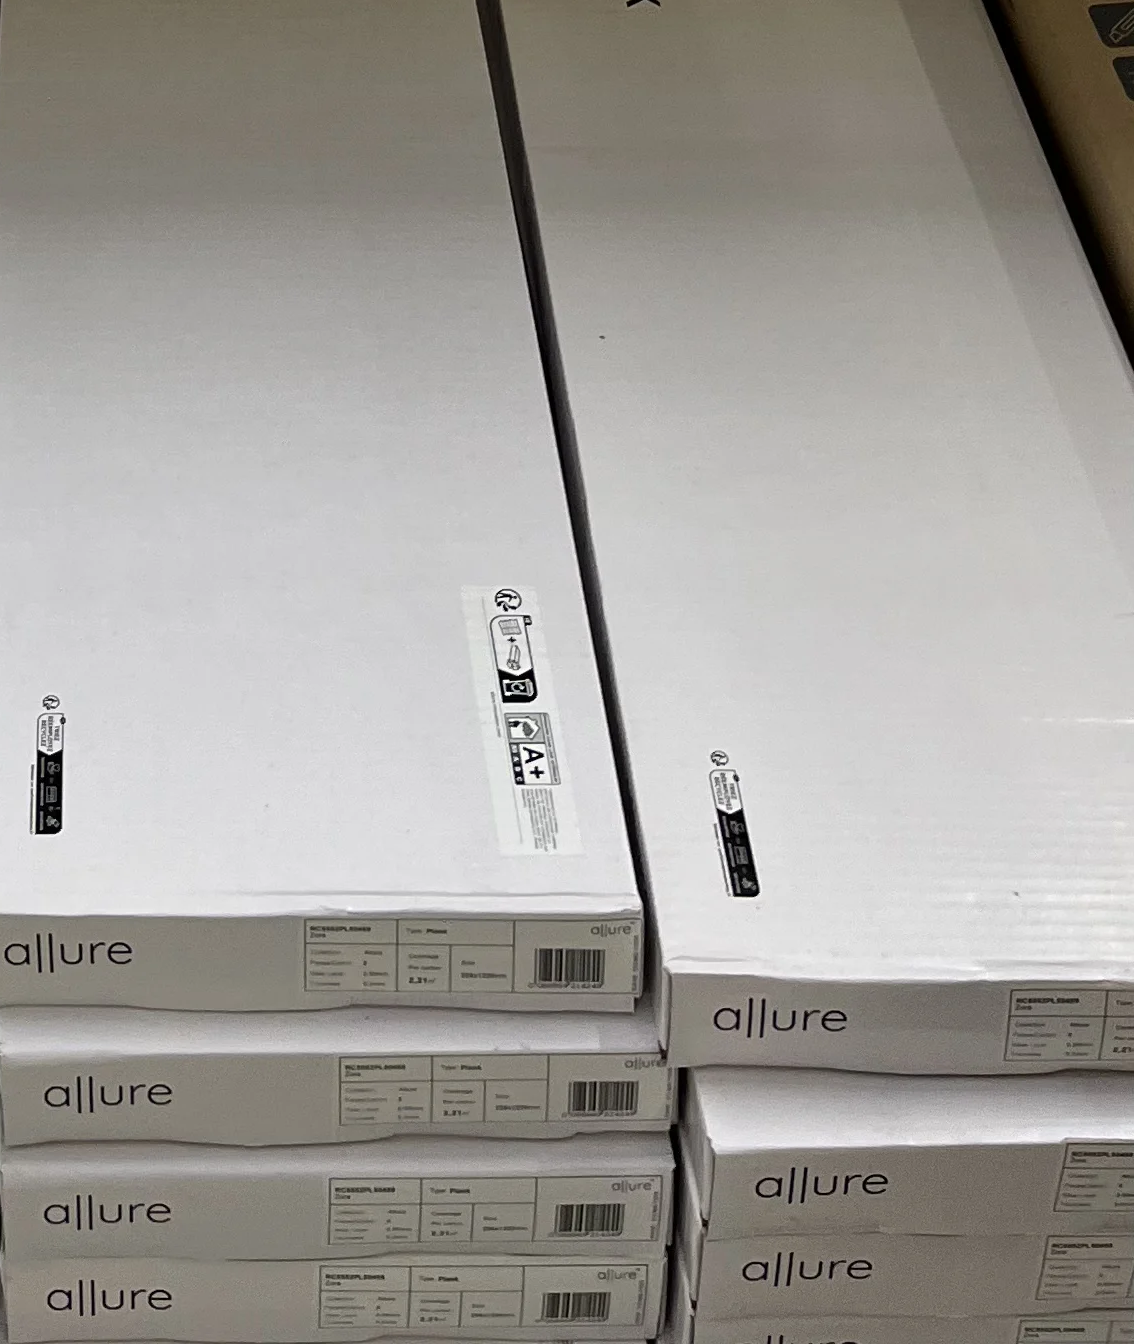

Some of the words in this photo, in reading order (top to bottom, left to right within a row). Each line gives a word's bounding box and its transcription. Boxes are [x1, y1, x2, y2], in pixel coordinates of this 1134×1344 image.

[522, 746, 545, 779] A+
[590, 924, 632, 937] allure
[4, 934, 133, 973] allure
[713, 998, 848, 1039] allure
[43, 1075, 174, 1113] allure
[610, 1180, 652, 1195] allure
[755, 1167, 890, 1204] allure
[42, 1197, 173, 1231] allure
[597, 1269, 637, 1284] allure
[741, 1252, 873, 1287] allure
[46, 1280, 174, 1316] allure
